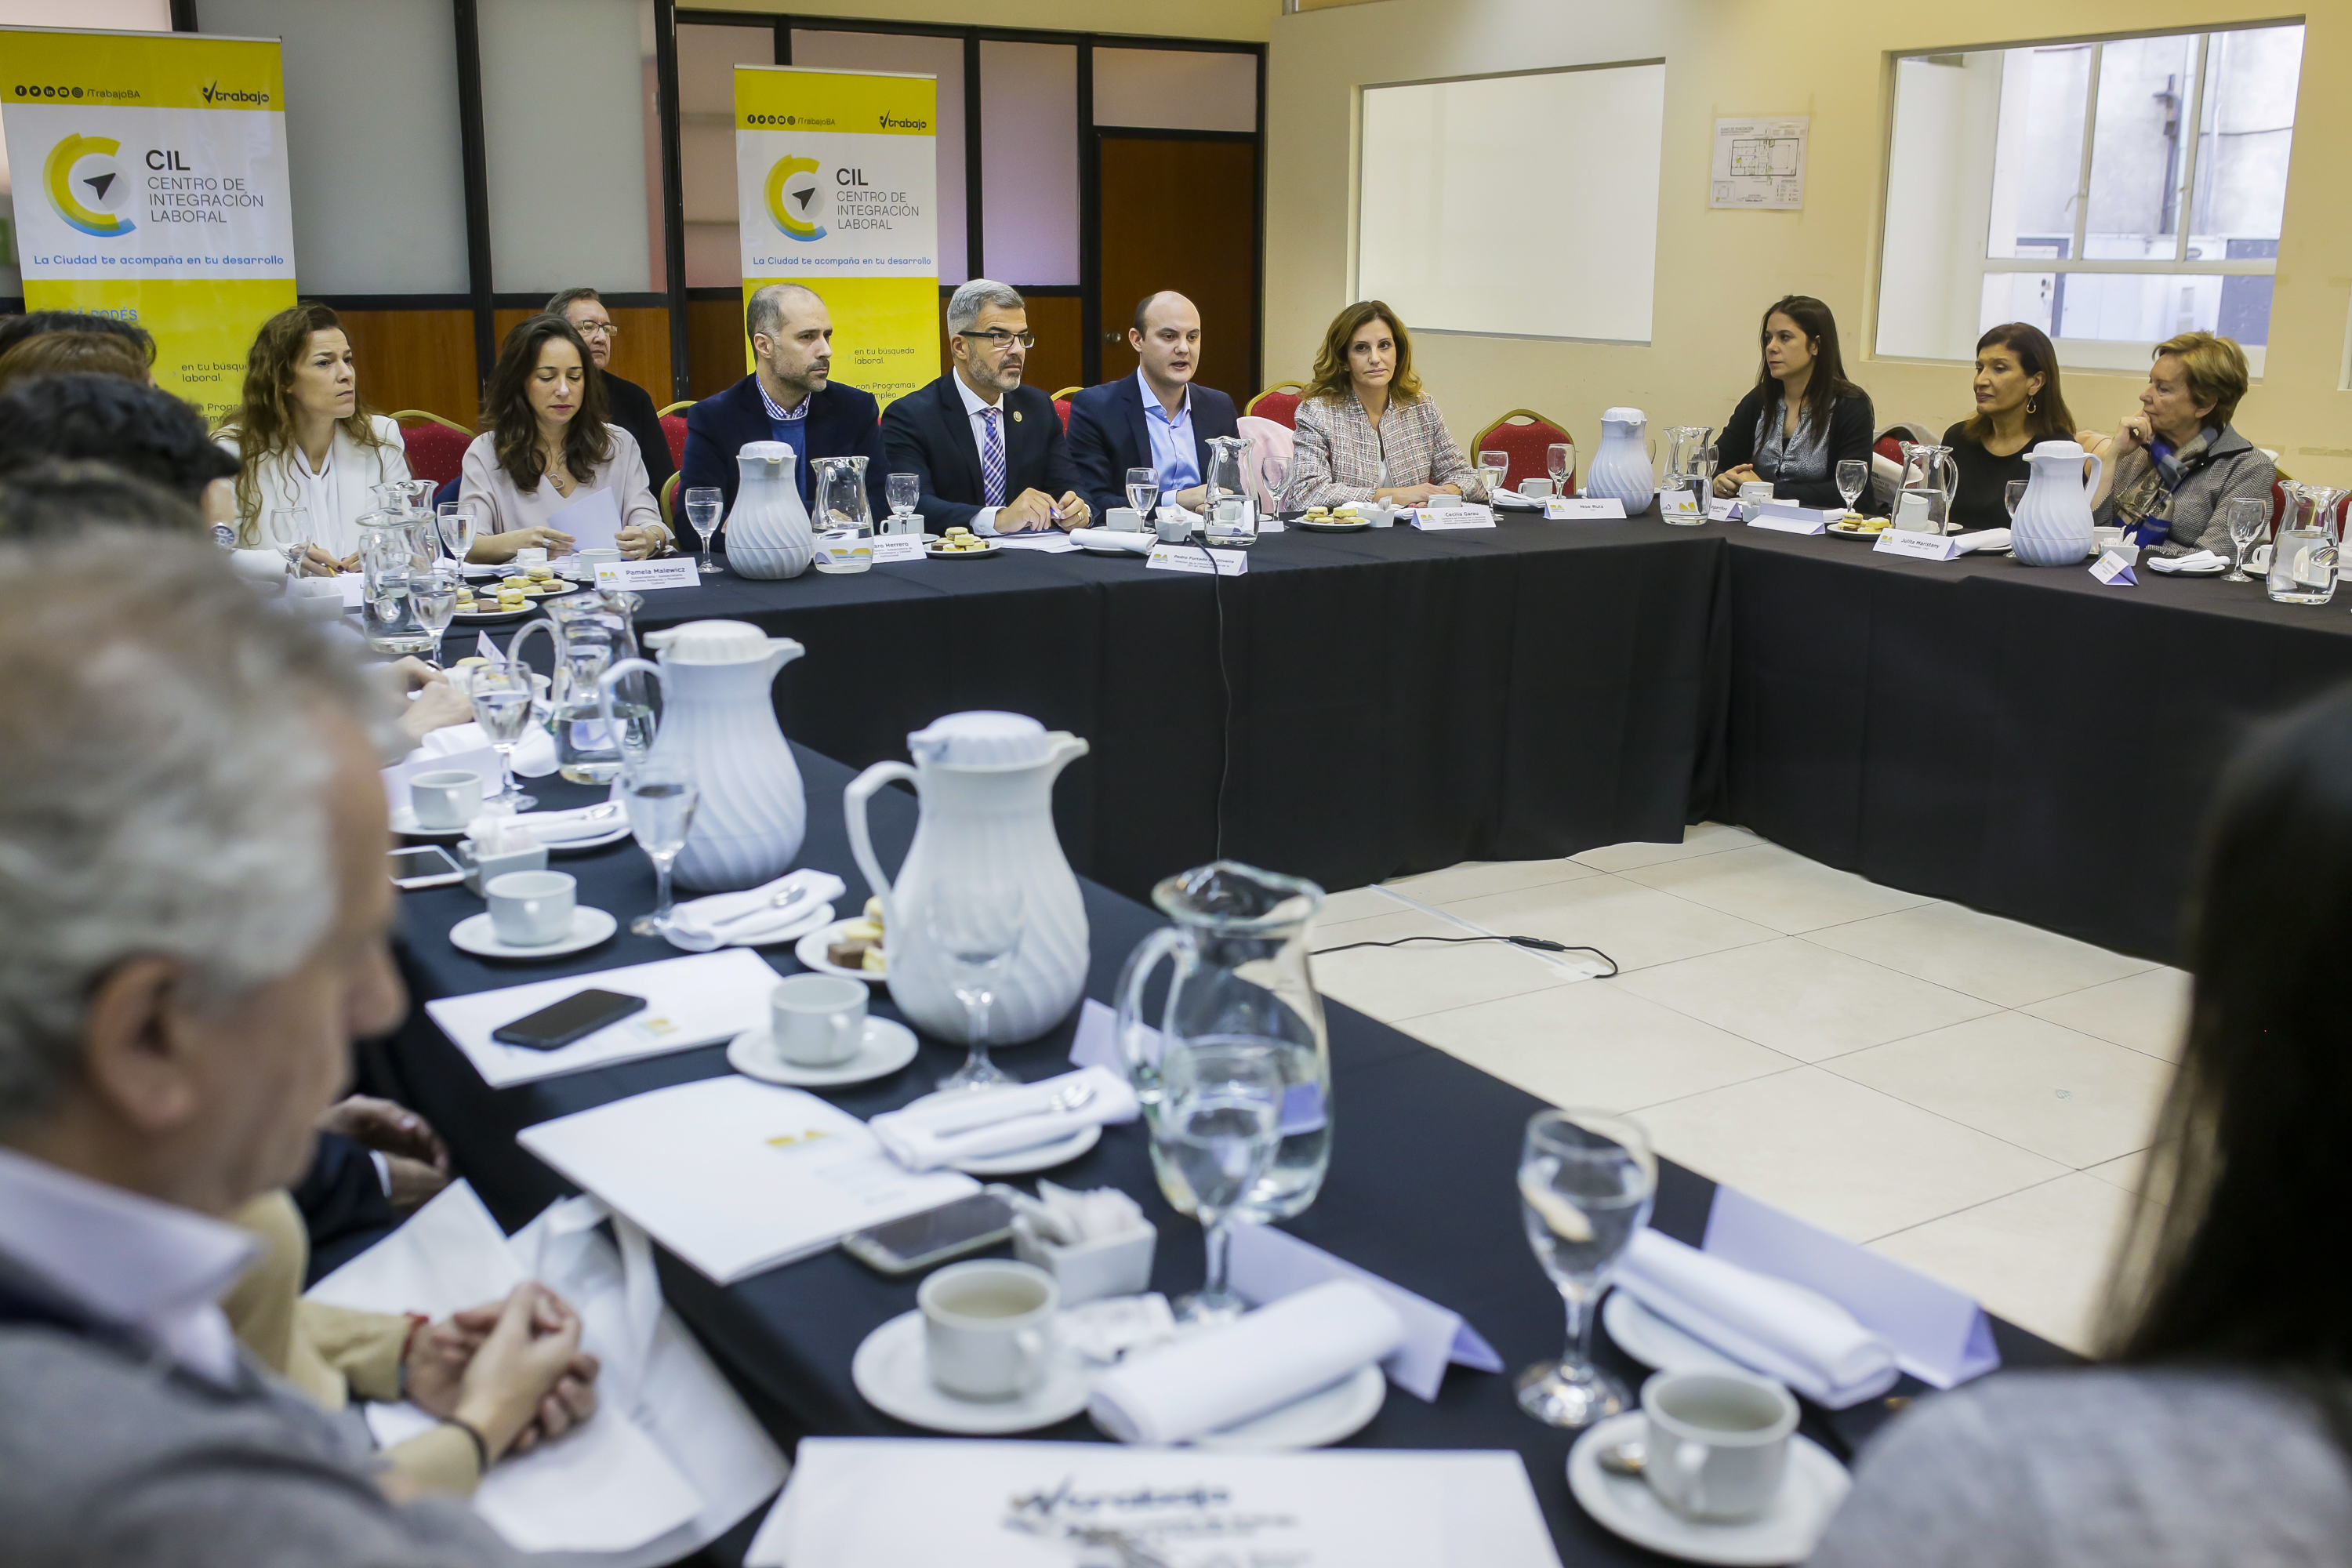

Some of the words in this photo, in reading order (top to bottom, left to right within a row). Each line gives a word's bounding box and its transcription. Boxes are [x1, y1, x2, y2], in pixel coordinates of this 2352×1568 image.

[86, 88, 141, 100] /TrabajoBA
[797, 118, 836, 126] /TrabajoBA
[145, 149, 191, 172] CIL
[836, 168, 869, 186] CIL
[147, 176, 217, 191] CENTRO
[223, 178, 245, 191] DE
[149, 191, 264, 208] INTEGRACIÓN
[837, 191, 887, 202] CENTRO
[891, 191, 907, 202] DE
[837, 202, 919, 216] INTEGRACIÓN
[151, 209, 227, 224] LABORAL
[838, 219, 892, 230] LABORAL
[34, 256, 49, 265] La
[53, 255, 97, 265] Ciudad
[102, 256, 116, 265] te
[120, 255, 183, 268] acompaña
[187, 256, 201, 265] en
[205, 256, 219, 265] tu
[223, 255, 284, 265] desarrollo
[768, 256, 799, 265] Ciudad
[815, 257, 860, 267] acompaña
[182, 373, 223, 382] laboral.
[873, 382, 916, 391] Programas
[1916, 540, 1940, 549] Maristany
